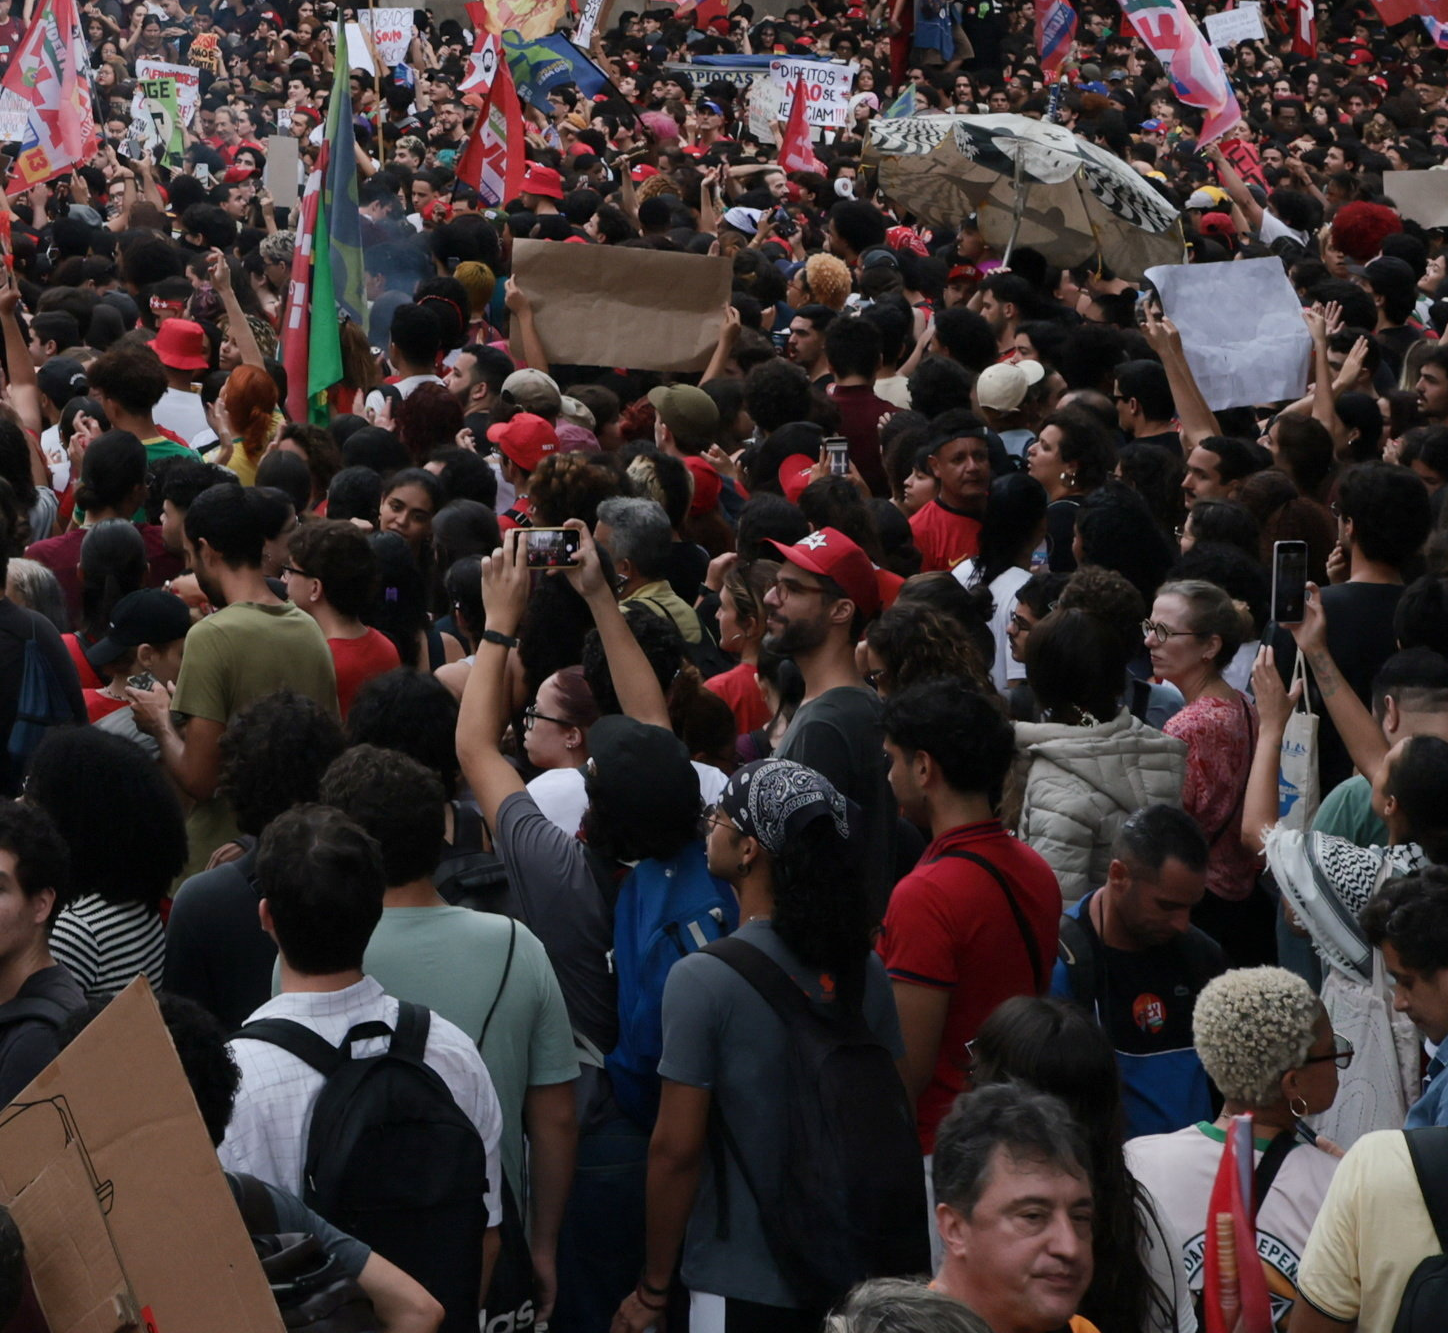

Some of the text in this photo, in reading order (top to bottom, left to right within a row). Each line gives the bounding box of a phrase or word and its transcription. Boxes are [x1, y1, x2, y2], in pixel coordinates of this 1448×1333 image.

[687, 70, 754, 85] APIOCAS
[781, 65, 835, 84] DIREITOS
[823, 88, 836, 102] SE
[25, 150, 49, 173] 13
